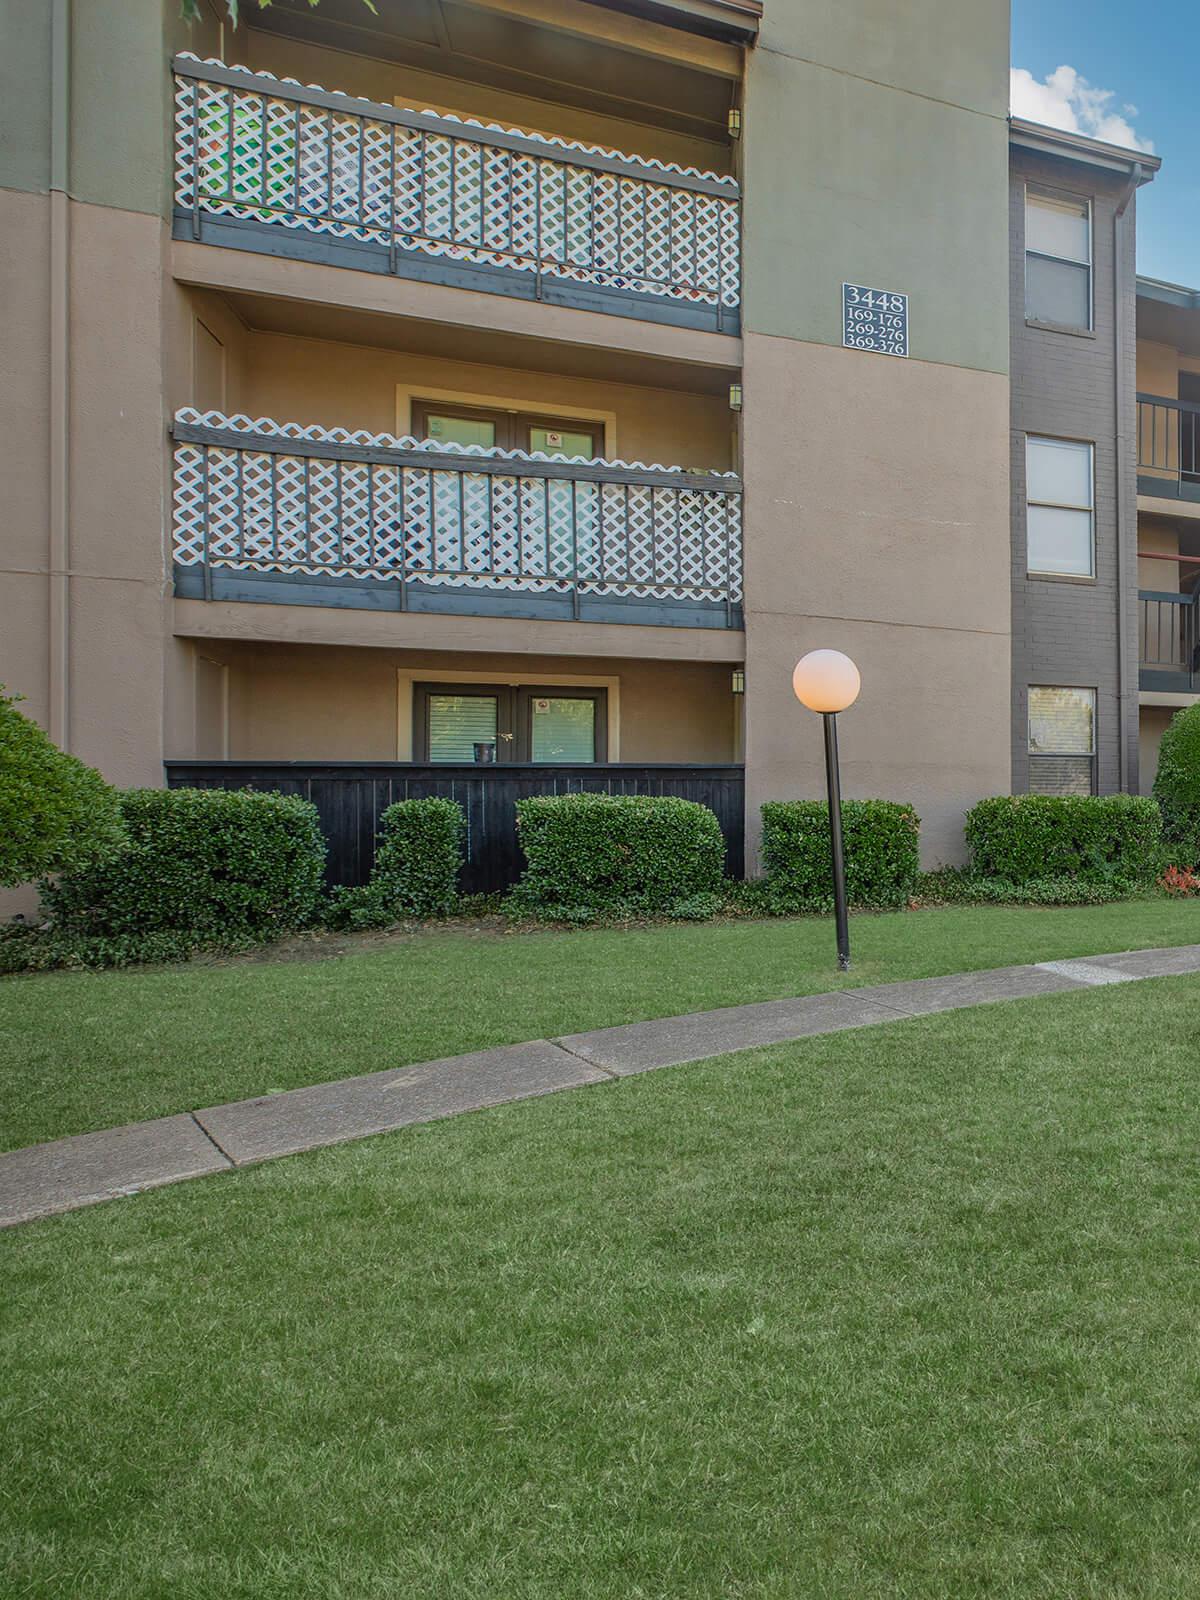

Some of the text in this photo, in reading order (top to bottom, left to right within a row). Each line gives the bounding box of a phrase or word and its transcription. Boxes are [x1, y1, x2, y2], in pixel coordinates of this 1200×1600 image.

[847, 287, 904, 312] 3448
[848, 307, 903, 328] 169-176
[847, 320, 904, 341] 269-276
[847, 334, 904, 354] 369-376
